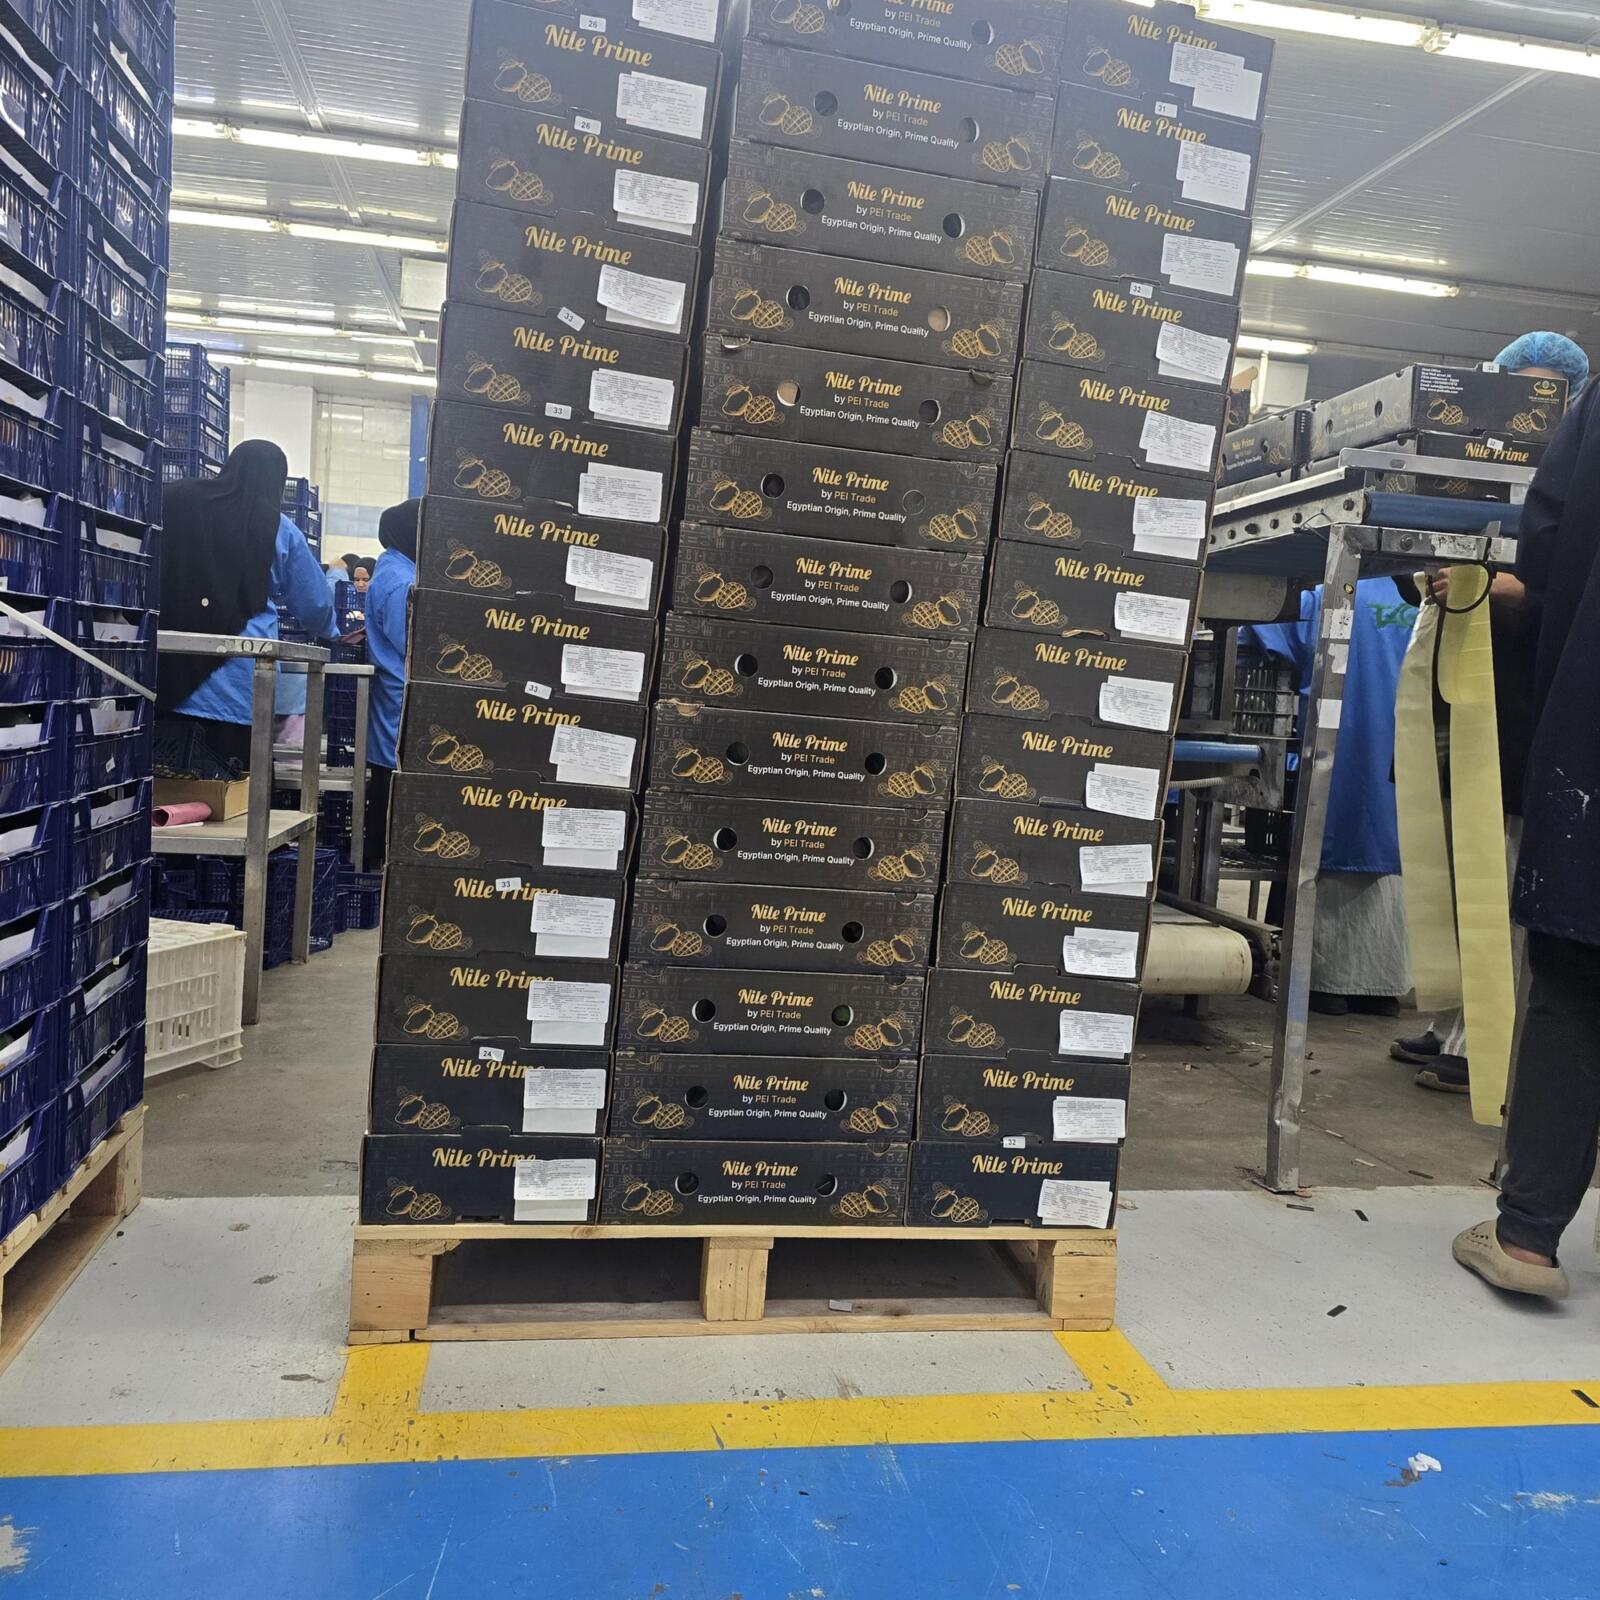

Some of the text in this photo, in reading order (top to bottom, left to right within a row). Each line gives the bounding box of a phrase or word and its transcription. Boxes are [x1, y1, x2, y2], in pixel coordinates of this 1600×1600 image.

[850, 17, 971, 51] Egyptian Origin, Prime Quality
[1127, 14, 1161, 40] Nile
[545, 24, 653, 67] Nile Prime
[863, 83, 941, 113] Nile Prime
[872, 107, 928, 126] by PEI Trade
[1117, 107, 1151, 133] Nile
[536, 123, 643, 165] Nile Prime
[837, 118, 959, 149] Egyptian Origin, Prime Quality
[847, 181, 924, 208] Nile Prime
[1105, 195, 1195, 232] Nile Prime
[525, 225, 632, 266] Nile Prime
[834, 277, 911, 303] Nile Prime
[843, 299, 898, 316] by PEI Trade
[1092, 288, 1183, 323] Nile Prime
[808, 311, 929, 337] Egyptian Origin, Prime Quality
[513, 326, 619, 363] Nile Prime
[825, 371, 901, 396] Nile Prime
[1079, 378, 1170, 412] Nile Prime
[799, 405, 919, 429] Egyptian Origin, Prime Quality
[503, 423, 608, 457] Nile Prime
[812, 467, 888, 491] Nile Prime
[1068, 469, 1102, 491] Nile
[820, 488, 876, 503] by PEI Trade
[786, 500, 906, 523] Egyptian Origin, Prime Quality
[494, 513, 600, 547] Nile Prime
[796, 557, 872, 580] Nile Prime
[1055, 557, 1144, 586] Nile Prime
[484, 608, 589, 639] Nile Prime
[783, 644, 858, 665] Nile Prime
[1035, 643, 1126, 670] Nile Prime
[791, 665, 846, 678] by PEI Trade
[757, 677, 876, 696] Egyptian Origin, Prime Quality
[475, 699, 516, 721] Nile
[772, 731, 847, 751] Nile Prime
[1022, 731, 1112, 758] Nile Prime
[461, 785, 501, 807] Nile
[762, 817, 837, 836] Nile Prime
[1013, 816, 1104, 842] Nile Prime
[770, 837, 824, 848] by PEI Trade
[737, 850, 854, 866] Egyptian Origin, Prime Quality
[453, 877, 494, 898] Nile
[751, 904, 826, 922] Nile Prime
[1002, 897, 1092, 922] Nile Prime
[450, 967, 490, 987] Nile
[738, 988, 813, 1006] Nile Prime
[989, 980, 1080, 1004] Nile Prime
[746, 1008, 801, 1019] by PEI Trade
[713, 1022, 831, 1035] Egyptian Origin, Prime Quality
[441, 1057, 481, 1077] Nile
[733, 1074, 808, 1091] Nile Prime
[982, 1068, 1074, 1090] Nile Prime
[432, 1147, 472, 1167] Nile
[722, 1160, 798, 1176] Nile Prime
[972, 1154, 1064, 1175] Nile Prime
[731, 1180, 785, 1190] by PEI Trade
[697, 1194, 816, 1204] Egyptian Origin, Prime Quality
